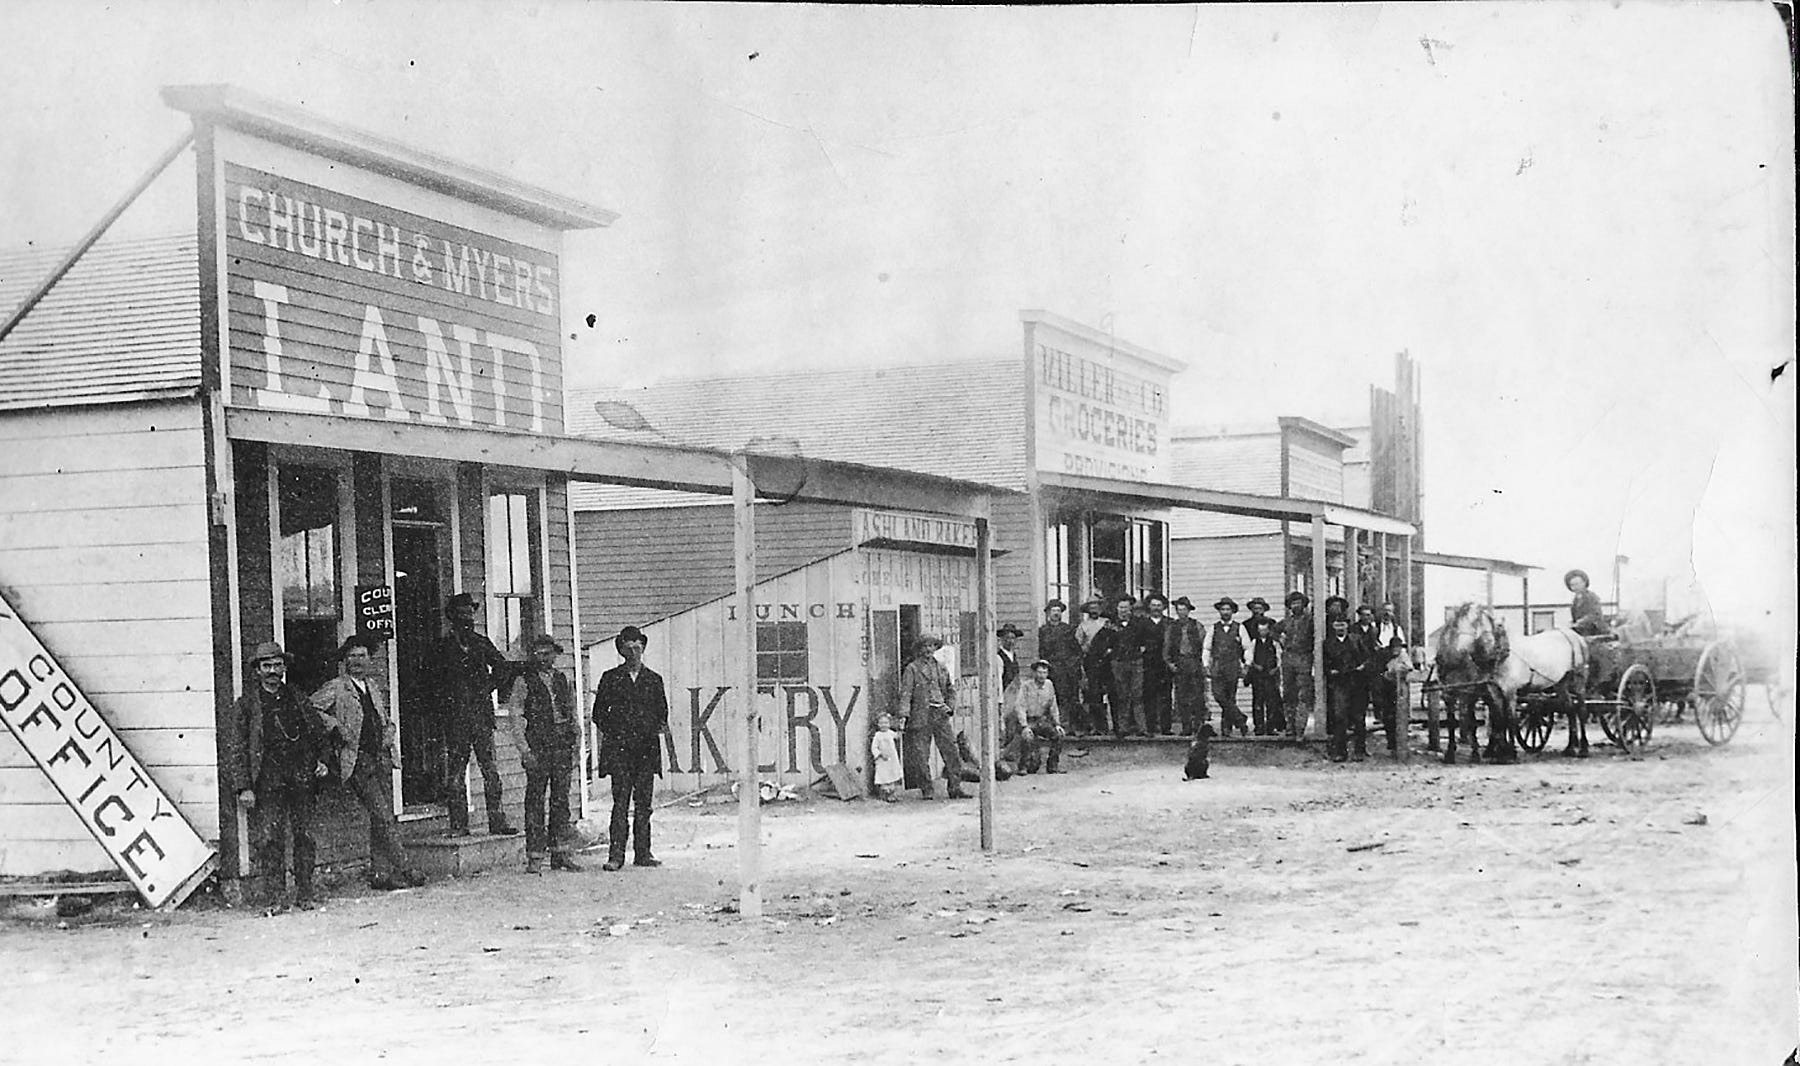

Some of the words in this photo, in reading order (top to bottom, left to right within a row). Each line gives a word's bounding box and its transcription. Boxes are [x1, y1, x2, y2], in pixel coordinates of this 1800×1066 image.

[239, 186, 402, 278] CHURCH
[411, 233, 432, 285] &
[442, 240, 554, 315] MYERS
[249, 280, 543, 432] LAND
[1048, 395, 1157, 456] GROCERIES
[0, 668, 166, 893] OFFICE.
[29, 654, 173, 821] COUNTY
